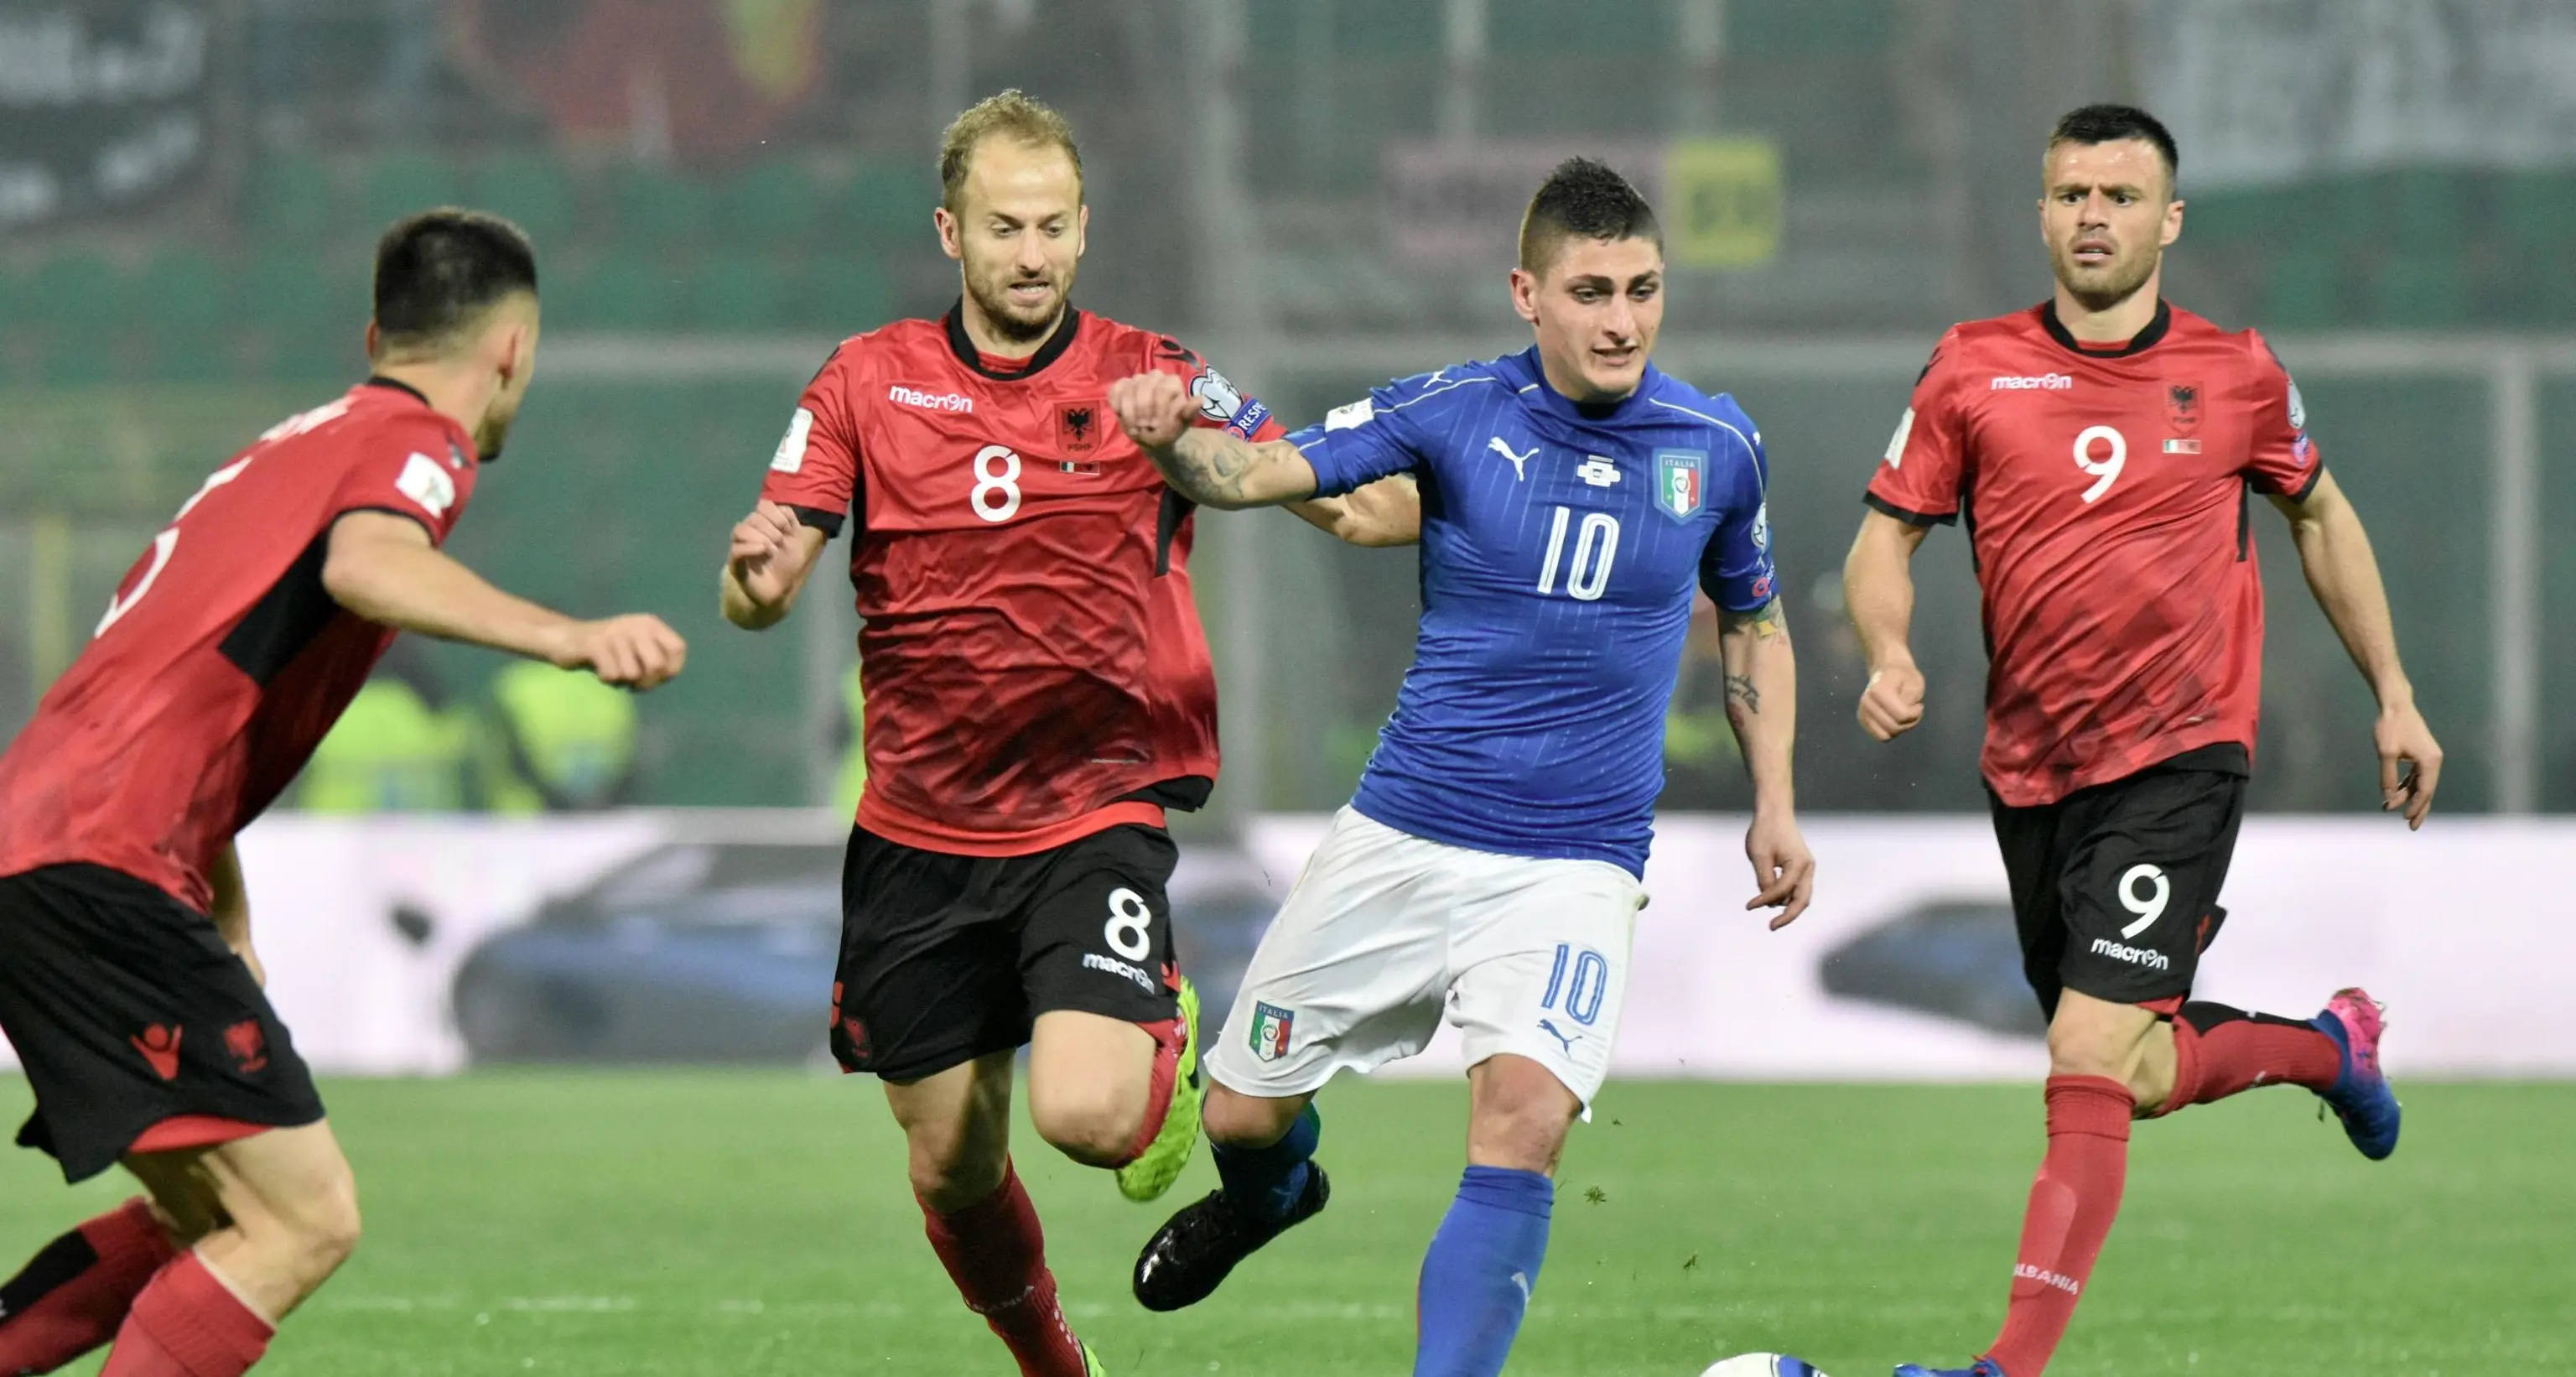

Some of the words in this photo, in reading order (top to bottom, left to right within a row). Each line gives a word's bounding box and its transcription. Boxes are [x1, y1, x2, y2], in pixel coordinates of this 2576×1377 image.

[971, 444, 1021, 522] 8
[1665, 459, 1695, 467] ITALIA
[2073, 425, 2127, 504] 9
[1536, 505, 1620, 601] 10
[1104, 886, 1152, 962] 8
[2118, 863, 2170, 940] 9
[1259, 1004, 1289, 1020] ITALIA
[1541, 943, 1607, 1026] 10
